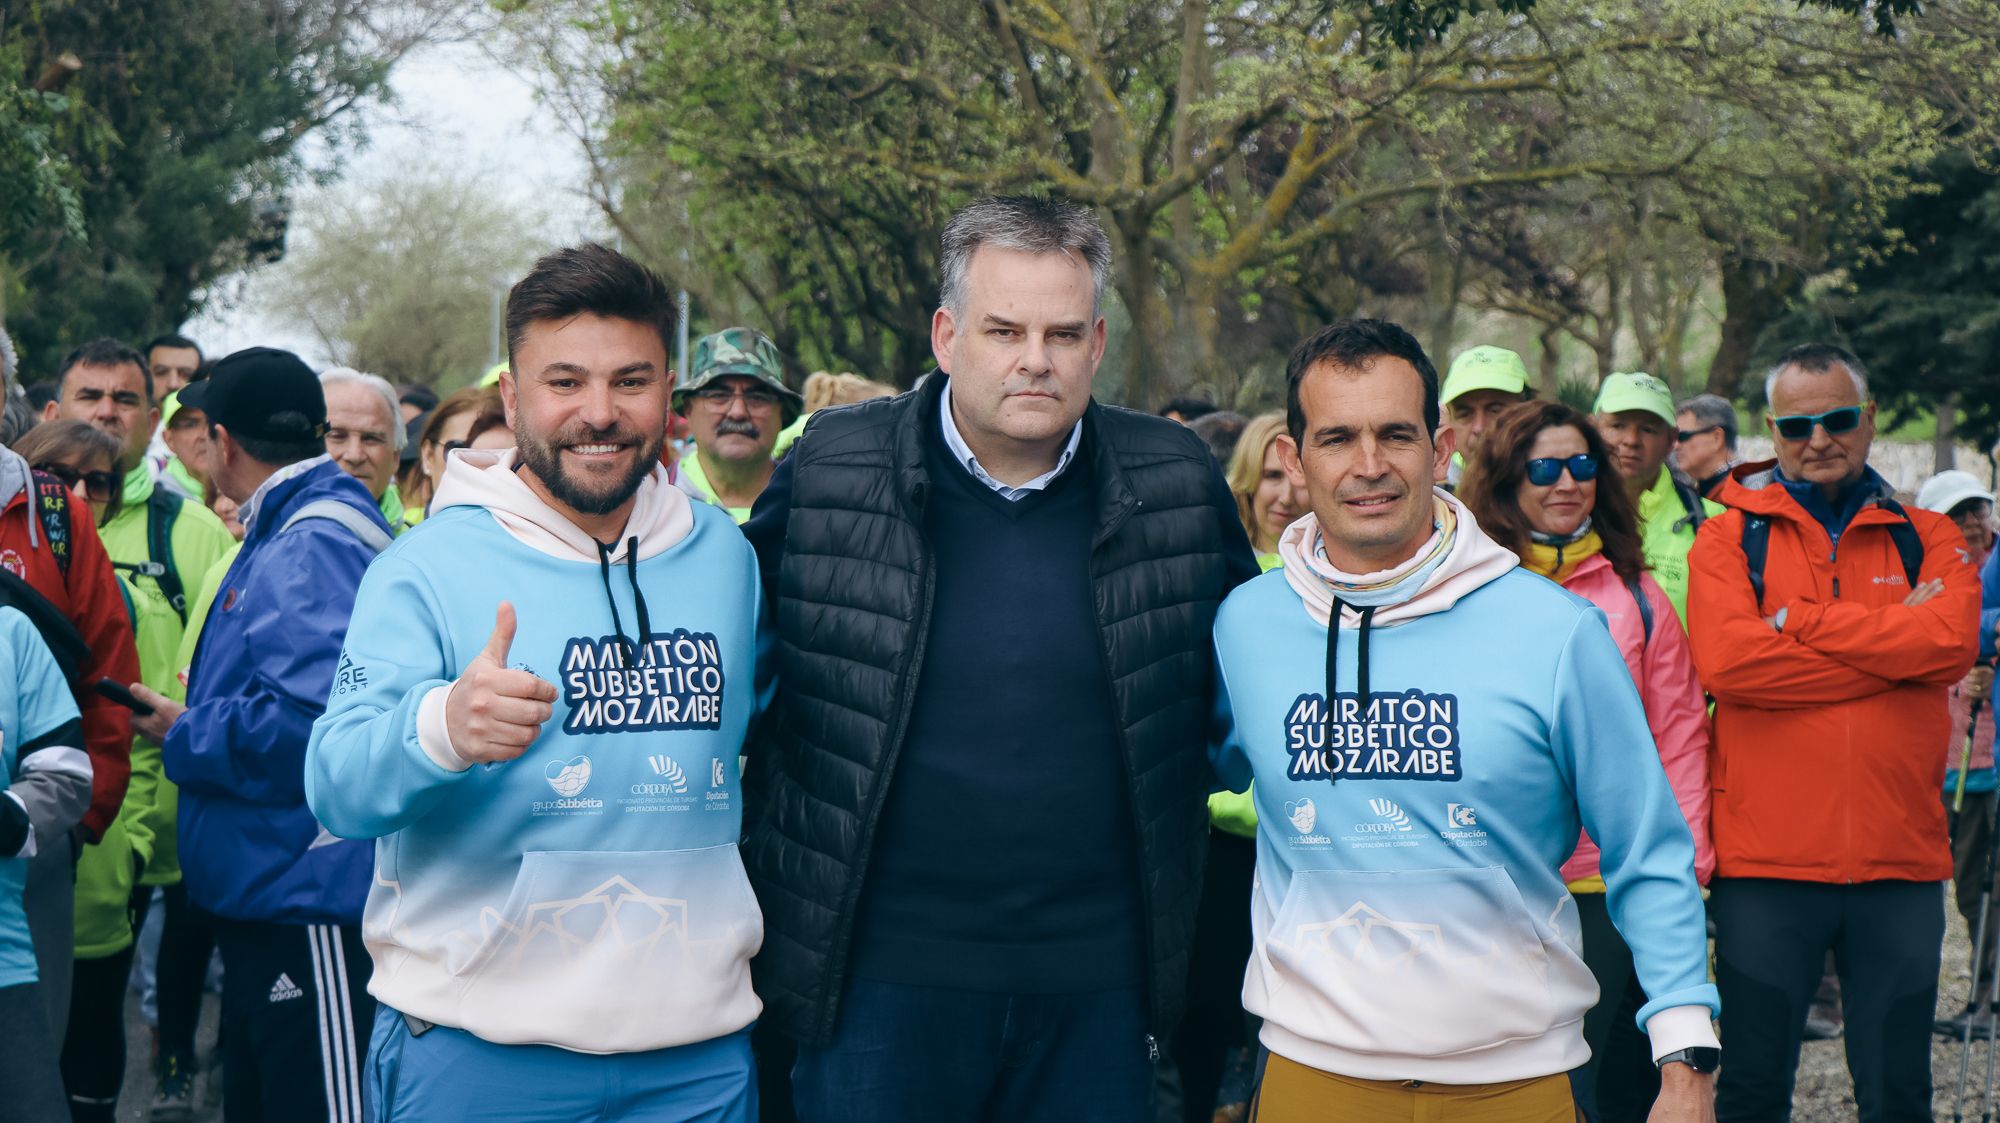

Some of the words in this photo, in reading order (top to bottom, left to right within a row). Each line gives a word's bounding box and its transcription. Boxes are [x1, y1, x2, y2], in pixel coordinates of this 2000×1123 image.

[569, 664, 721, 699] SUBBÉTICO
[571, 692, 720, 728] MOZÁRABE
[1290, 719, 1453, 749] SUBBÉTICO
[1293, 747, 1455, 775] MOZÁRABE
[270, 987, 303, 1002] adidas
